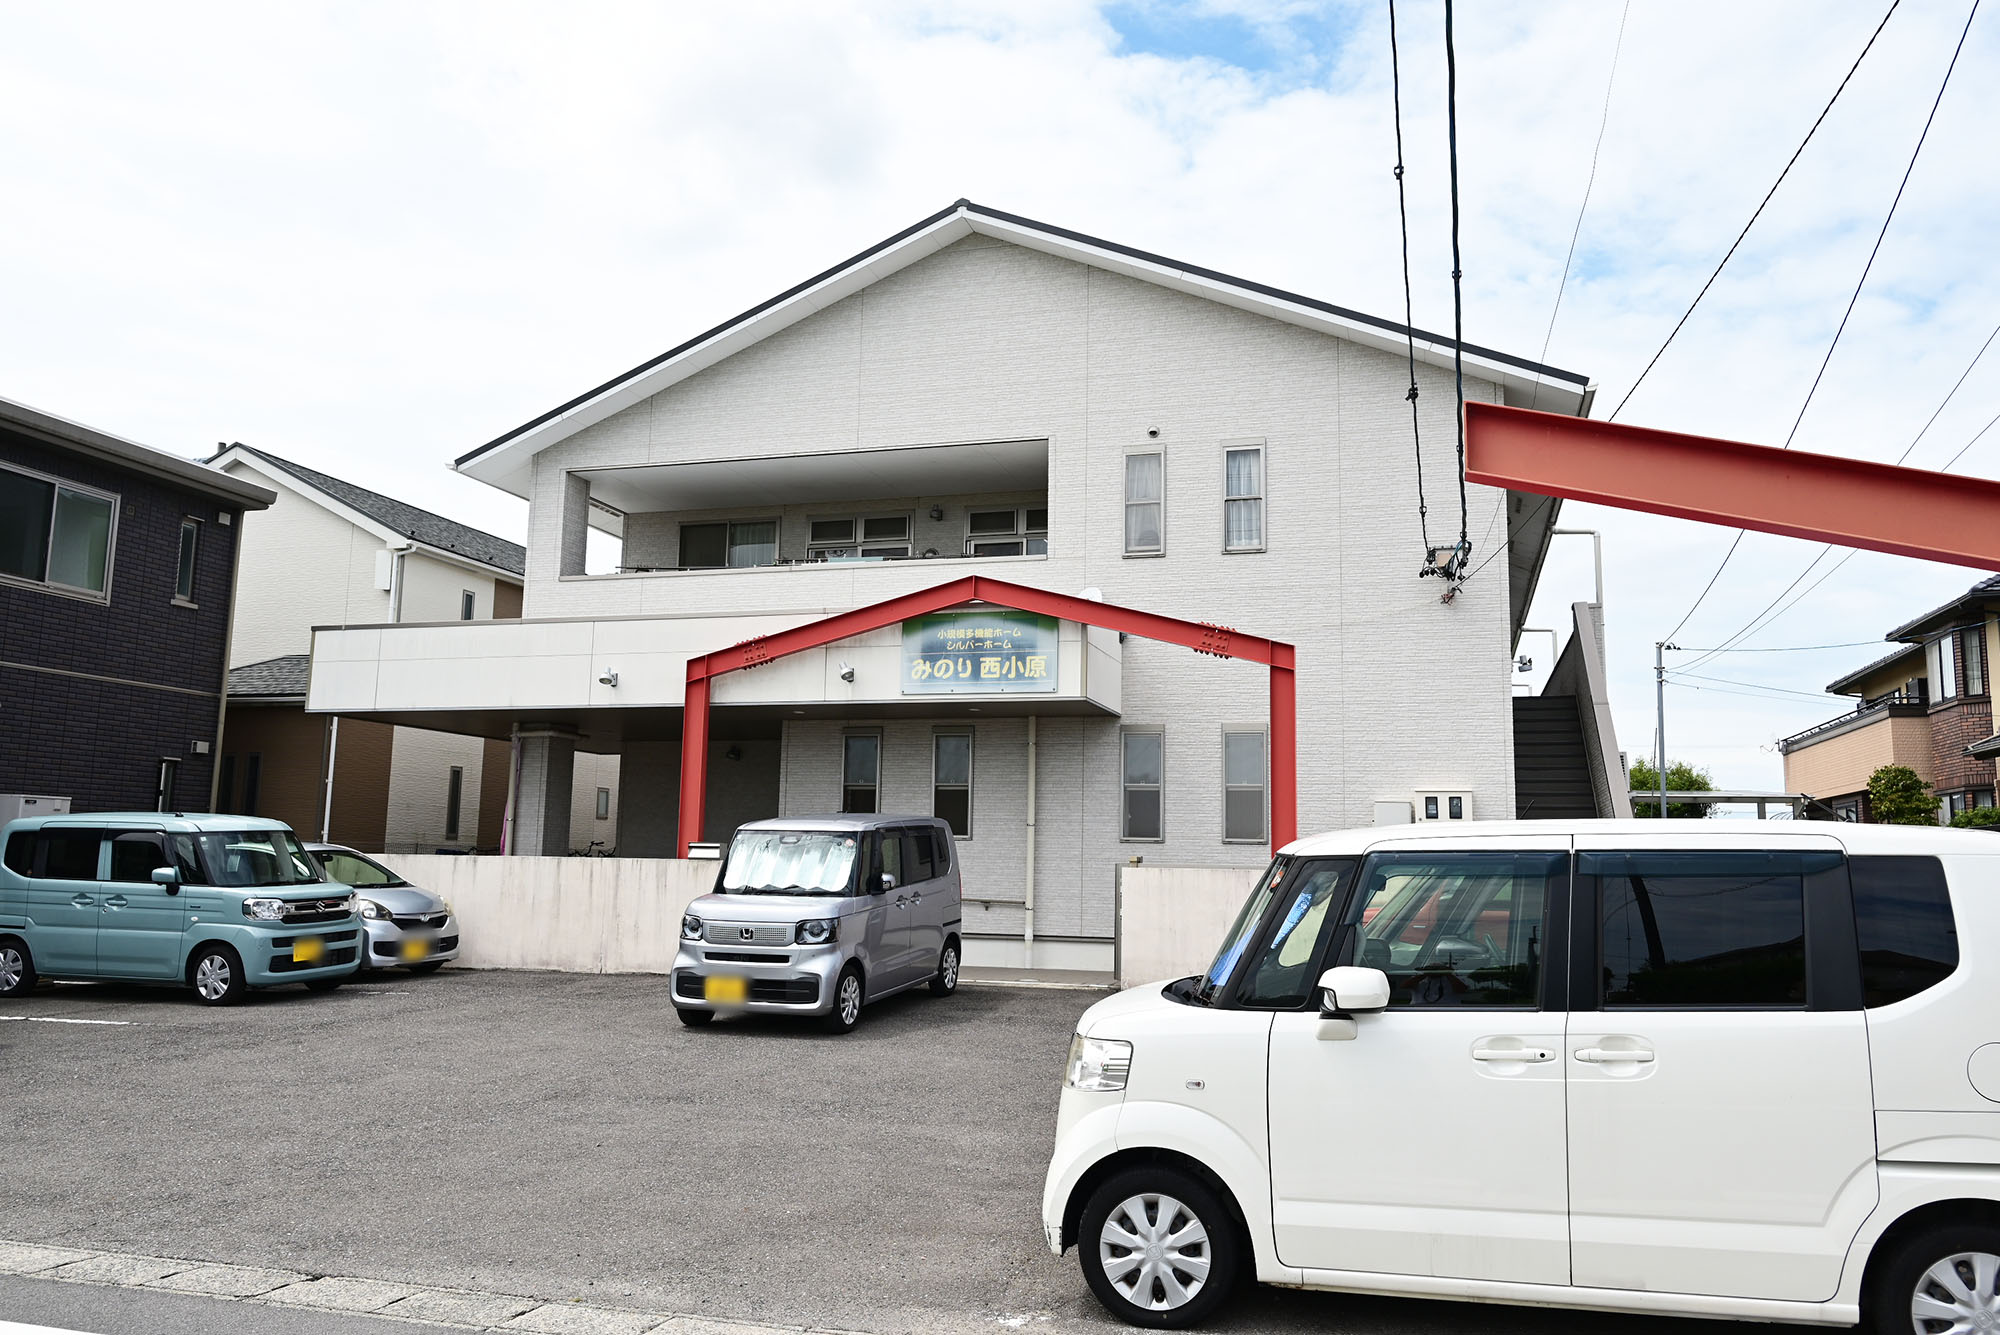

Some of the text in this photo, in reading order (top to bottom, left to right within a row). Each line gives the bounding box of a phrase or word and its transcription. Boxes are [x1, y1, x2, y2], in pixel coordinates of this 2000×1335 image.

[937, 627, 1022, 639] 小規模多機能ホーム
[946, 640, 1013, 650] シルバーホーム
[911, 656, 1047, 680] みのり 西小原
